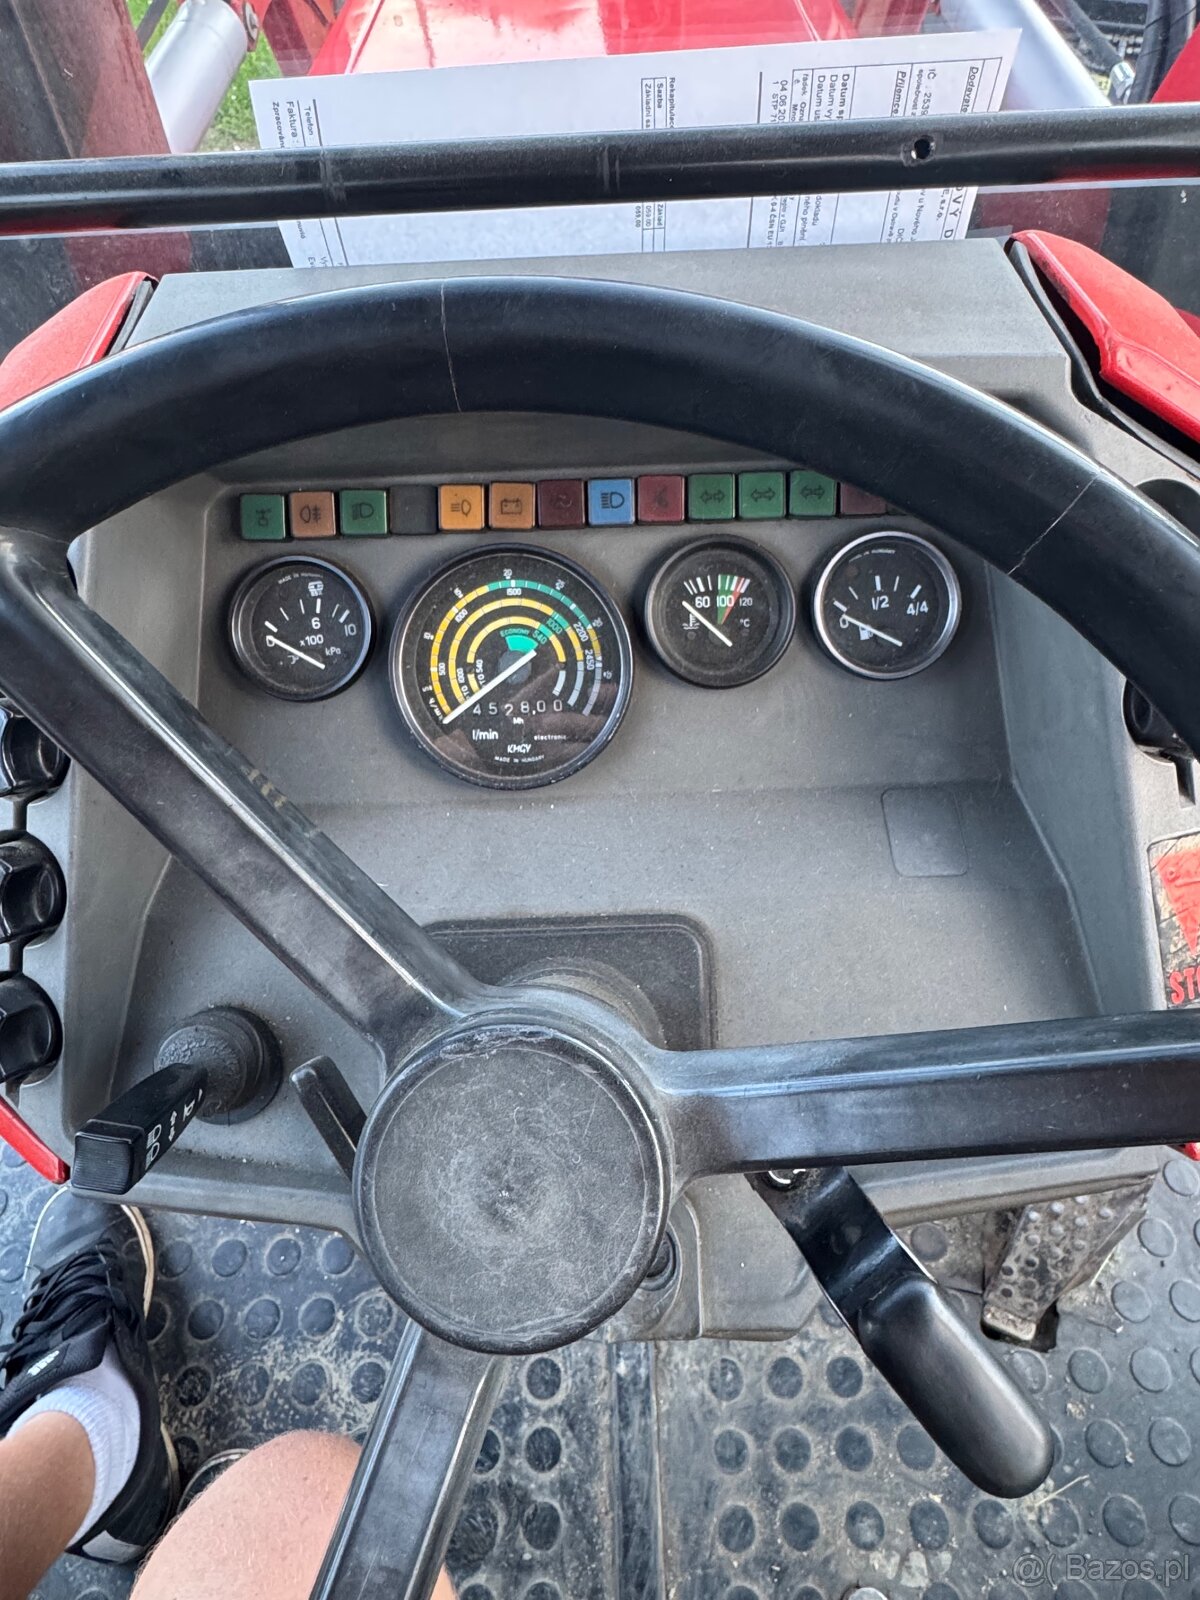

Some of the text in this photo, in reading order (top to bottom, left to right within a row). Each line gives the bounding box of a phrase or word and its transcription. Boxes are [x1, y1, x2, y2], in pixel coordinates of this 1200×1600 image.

[656, 82, 664, 108] Sazba
[815, 75, 826, 107] Datum
[827, 74, 838, 106] Datum
[839, 74, 850, 107] Datum
[286, 101, 297, 138] Faktura
[506, 588, 522, 596] 1500
[695, 595, 753, 608] 60 100 120
[871, 595, 929, 616] 1/2 4/4
[311, 616, 321, 630] 6
[739, 618, 750, 627] °C
[839, 615, 850, 629] 0
[344, 623, 357, 637] 10
[500, 627, 530, 637] ECONOMY
[532, 629, 548, 644] 540
[573, 621, 589, 642] 2200
[325, 646, 342, 656] kPa
[475, 659, 484, 673] 540
[584, 649, 595, 670] 2450
[438, 662, 446, 676] 500
[494, 755, 510, 763] MADE
